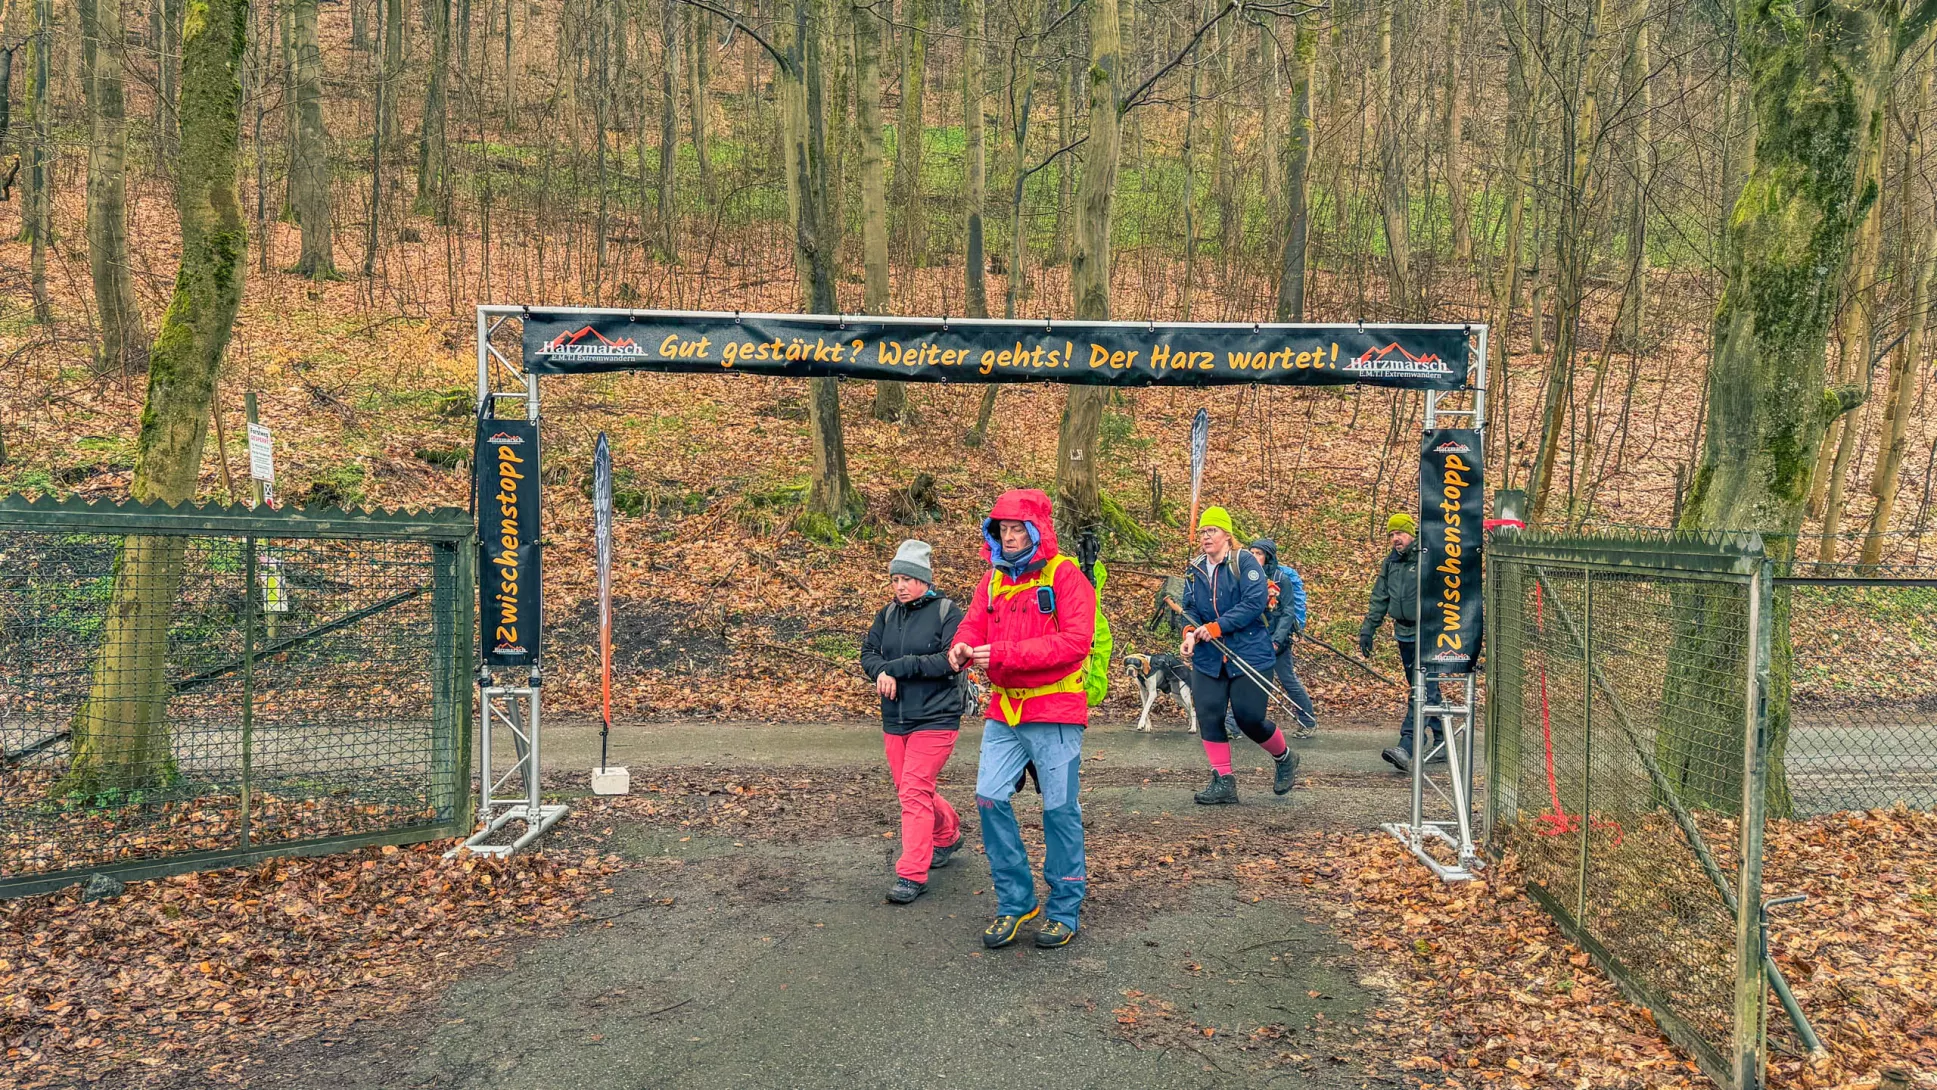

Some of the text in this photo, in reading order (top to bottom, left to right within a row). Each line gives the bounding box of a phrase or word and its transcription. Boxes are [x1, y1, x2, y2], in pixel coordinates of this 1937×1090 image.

[543, 341, 643, 355] Harzmarsch
[659, 334, 1339, 375] Gut gestärkt? Weiter gehts! Der Harz wartet!
[1350, 358, 1448, 371] Harzmarsch
[1385, 371, 1442, 379] Extremwandern
[493, 445, 524, 643] Zwischenstopp
[1436, 454, 1471, 651] Zwischenstopp
